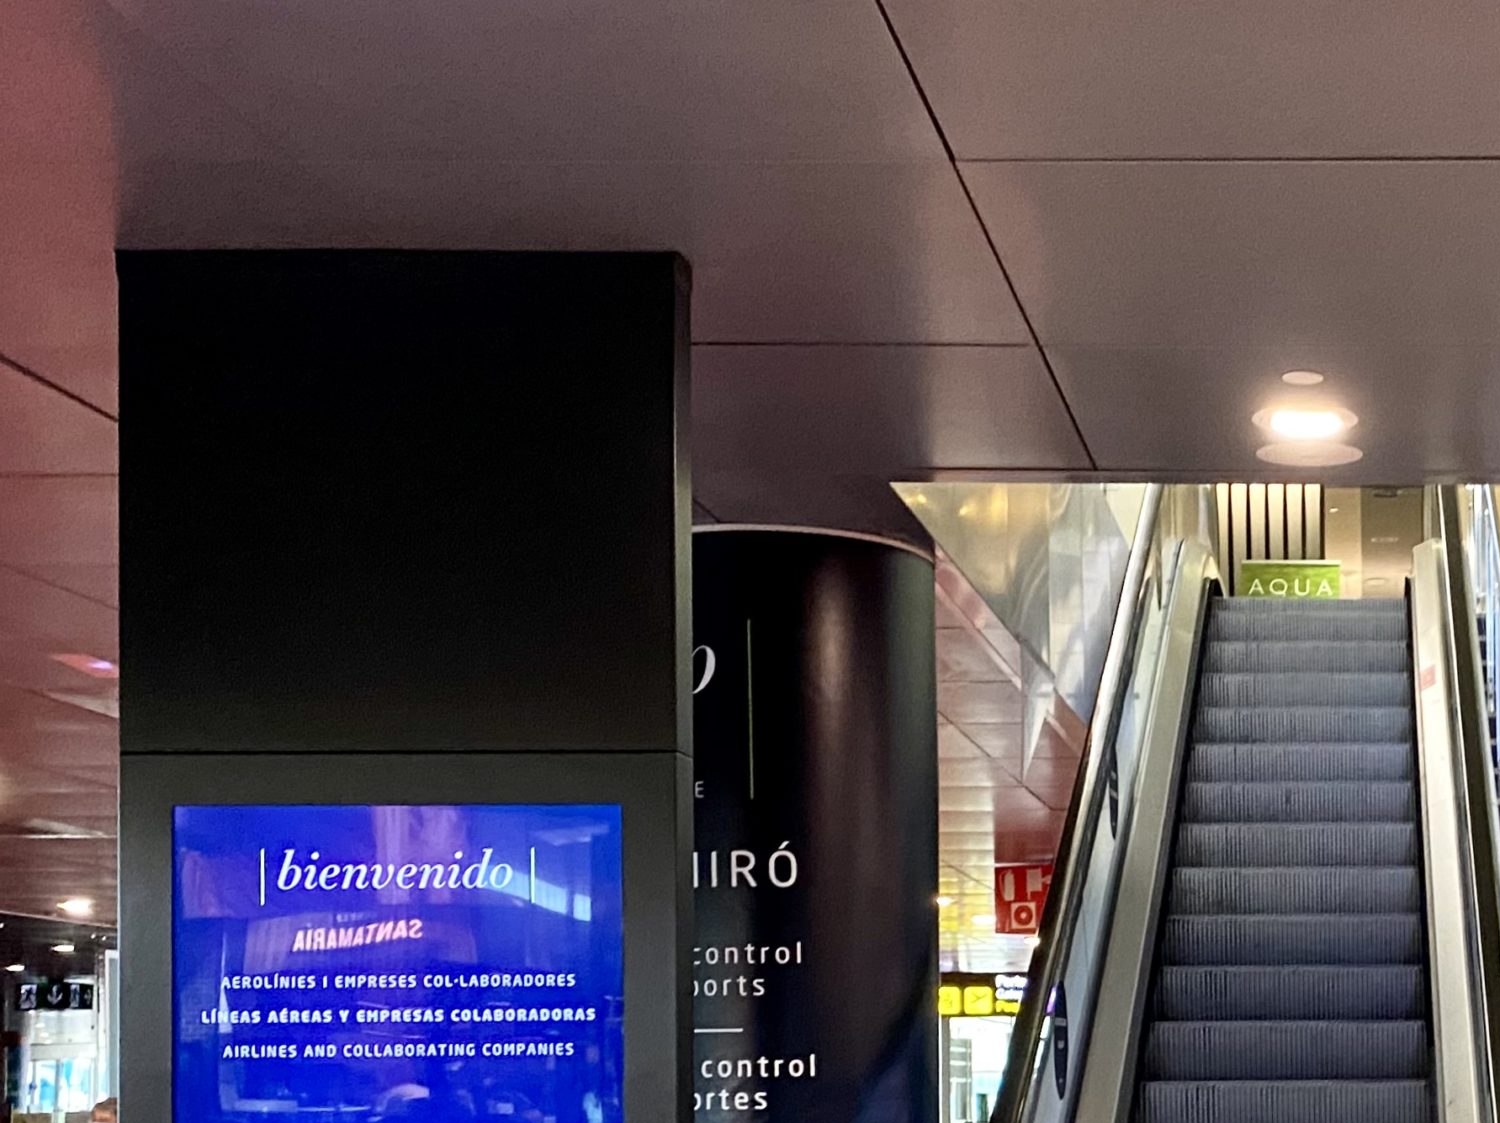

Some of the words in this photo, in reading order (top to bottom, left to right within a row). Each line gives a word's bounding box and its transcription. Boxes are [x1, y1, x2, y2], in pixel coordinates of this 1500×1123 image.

[1247, 578, 1335, 598] AQUA
[278, 847, 515, 892] bienvenido
[221, 972, 316, 990] AEROLÍNIES
[323, 975, 328, 988] I
[334, 974, 417, 988] EMPRESES
[202, 1008, 261, 1024] LÍNEAS
[267, 1008, 333, 1024] AÉREAS
[339, 1010, 348, 1023] Y
[356, 1009, 444, 1023] EMPRESAS
[450, 1008, 596, 1023] COLABORADORAS
[223, 1044, 297, 1059] AIRLINES
[304, 1044, 337, 1058] AND
[343, 1042, 475, 1058] COLLABORATING
[482, 1042, 574, 1057] COMPANIES
[701, 1054, 815, 1078] control
